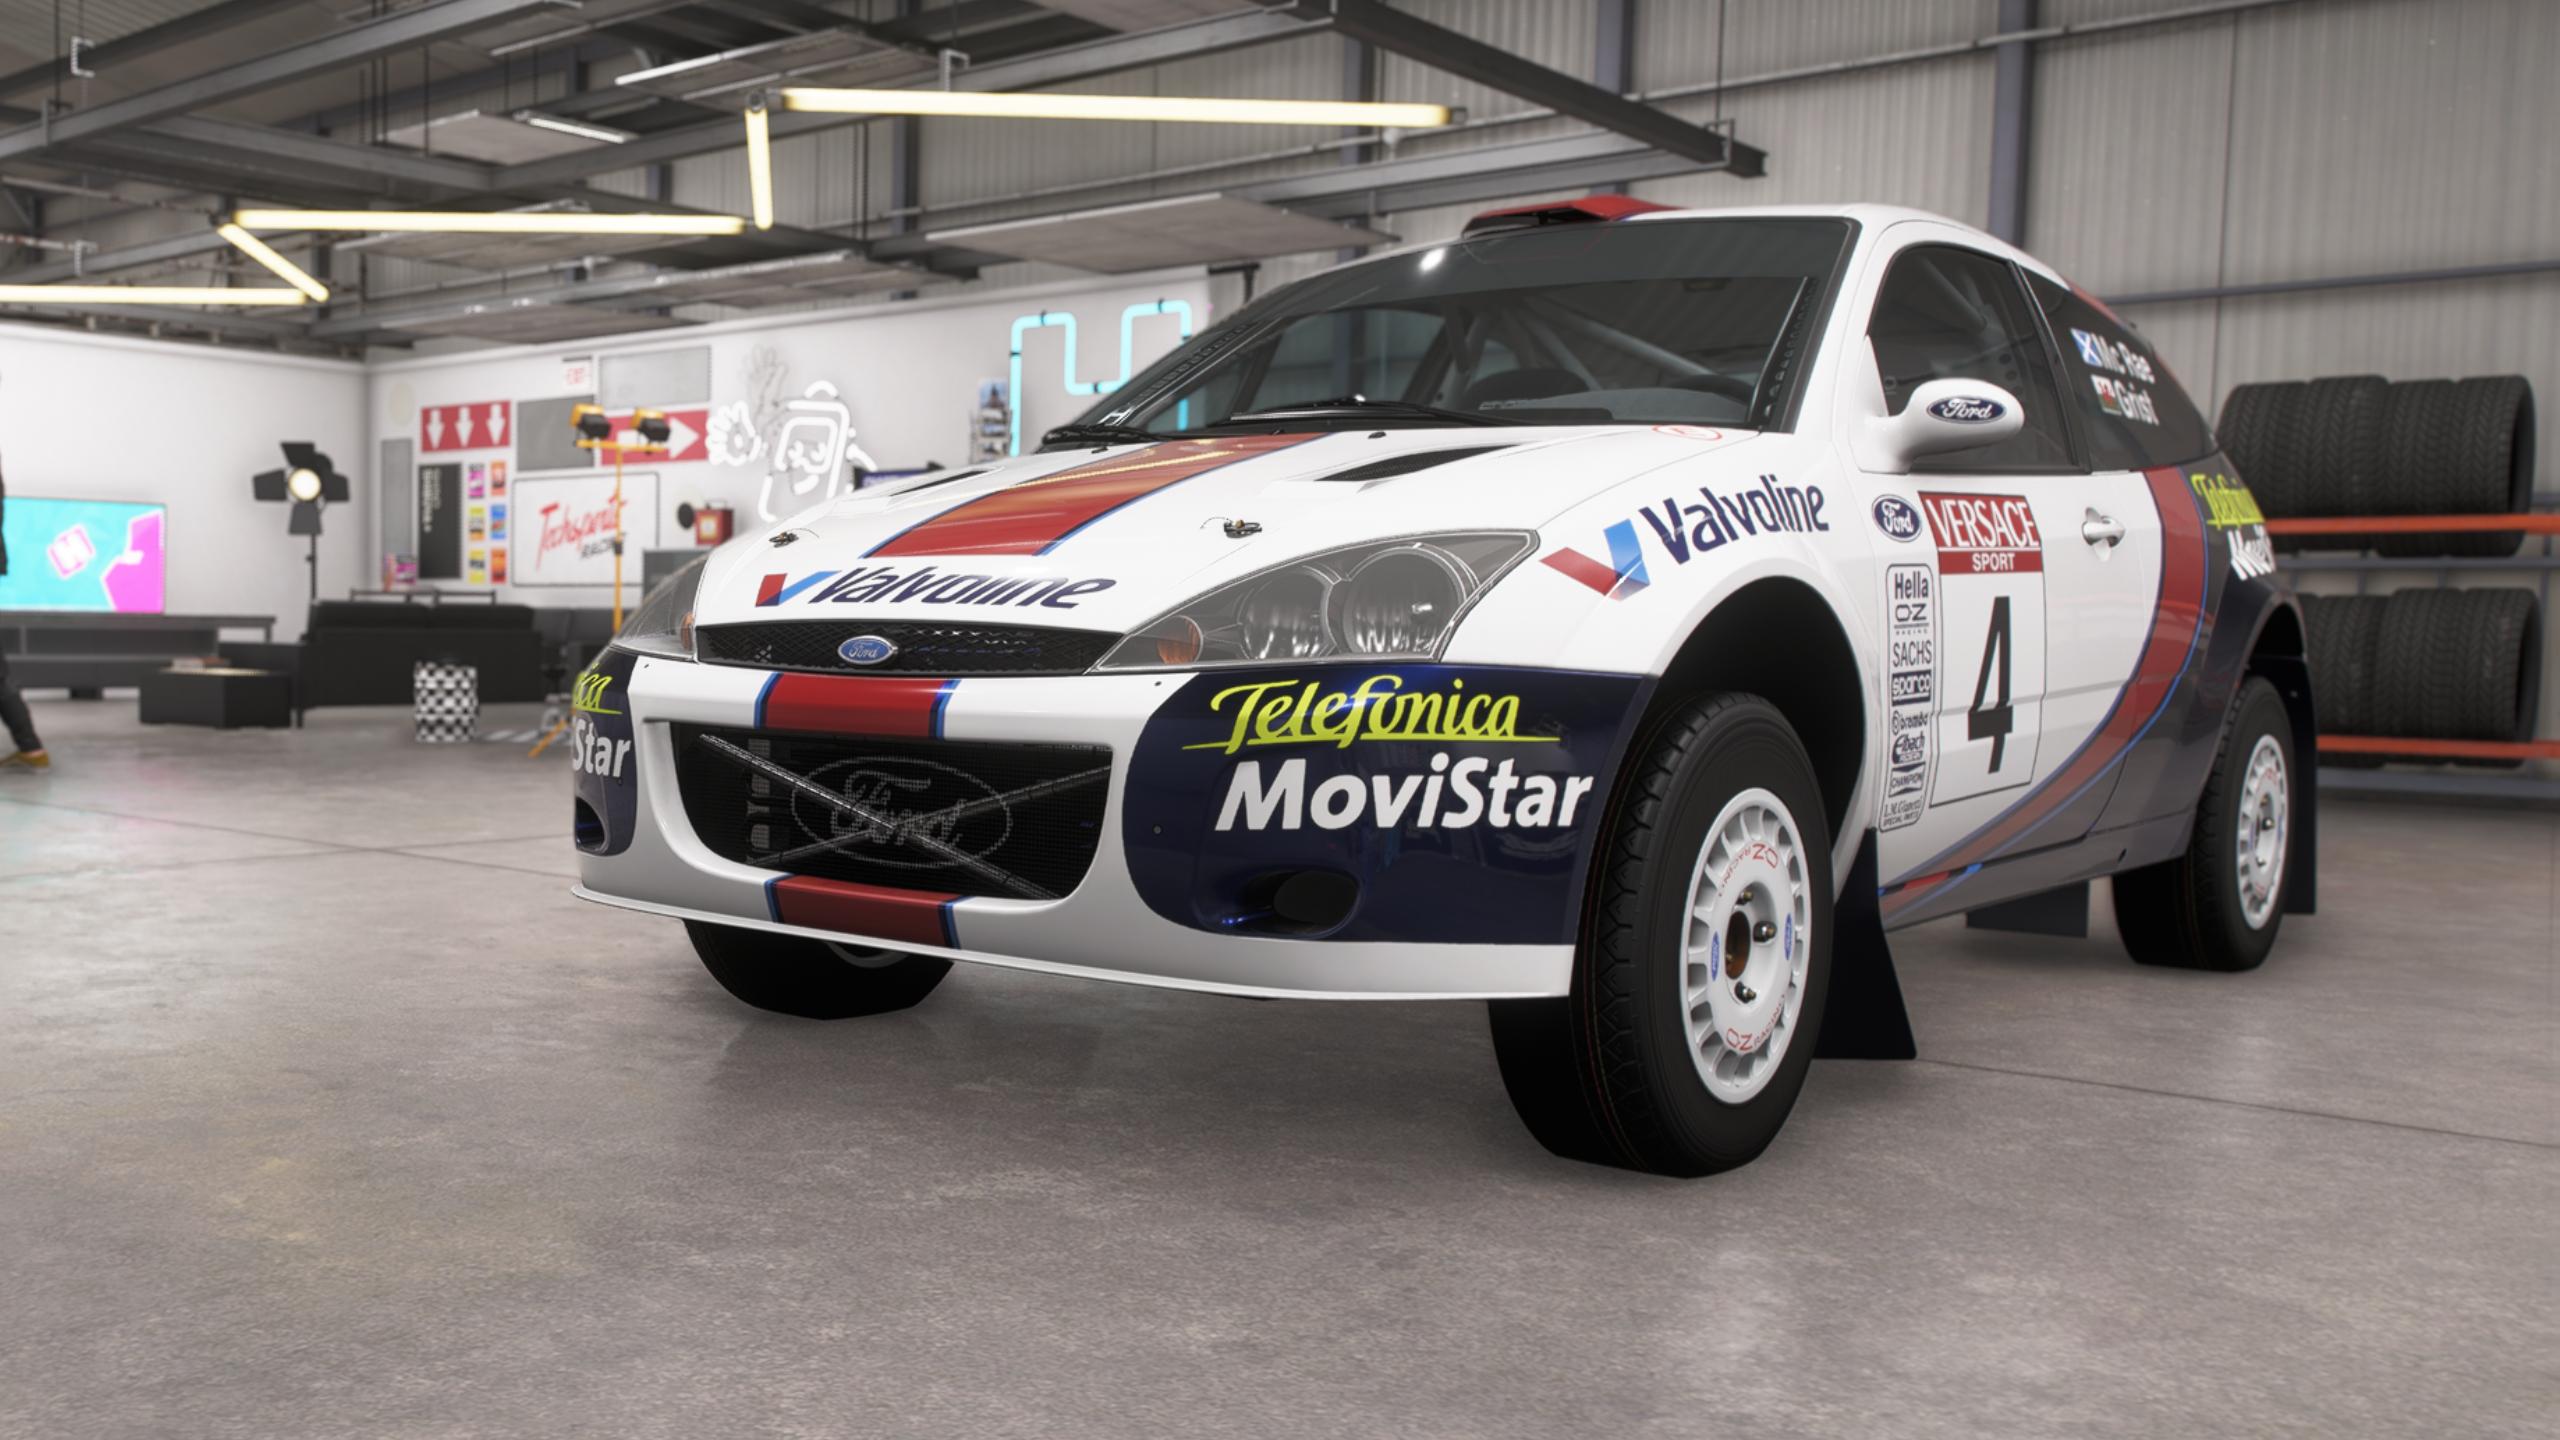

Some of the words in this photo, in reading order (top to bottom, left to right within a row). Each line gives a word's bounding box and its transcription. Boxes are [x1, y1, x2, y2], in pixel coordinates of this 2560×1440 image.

[1942, 398, 1993, 419] Ford
[2113, 379, 2160, 426] Grist
[1637, 474, 1830, 565] Valvoline
[1881, 500, 1915, 534] Ford
[1925, 499, 2040, 547] VERSACE
[1972, 552, 2016, 572] SPORT
[808, 566, 1117, 609] Valvoline
[1894, 570, 1930, 600] Hella
[1894, 603, 1927, 622] OZ
[848, 640, 881, 659] Ford
[1892, 639, 1932, 668] SACHS
[1893, 674, 1931, 700] sparco
[1967, 595, 2014, 775] 4
[1215, 751, 1594, 831] MoviStar
[1752, 843, 1779, 869] OZ
[1725, 1027, 1753, 1051] OZ
